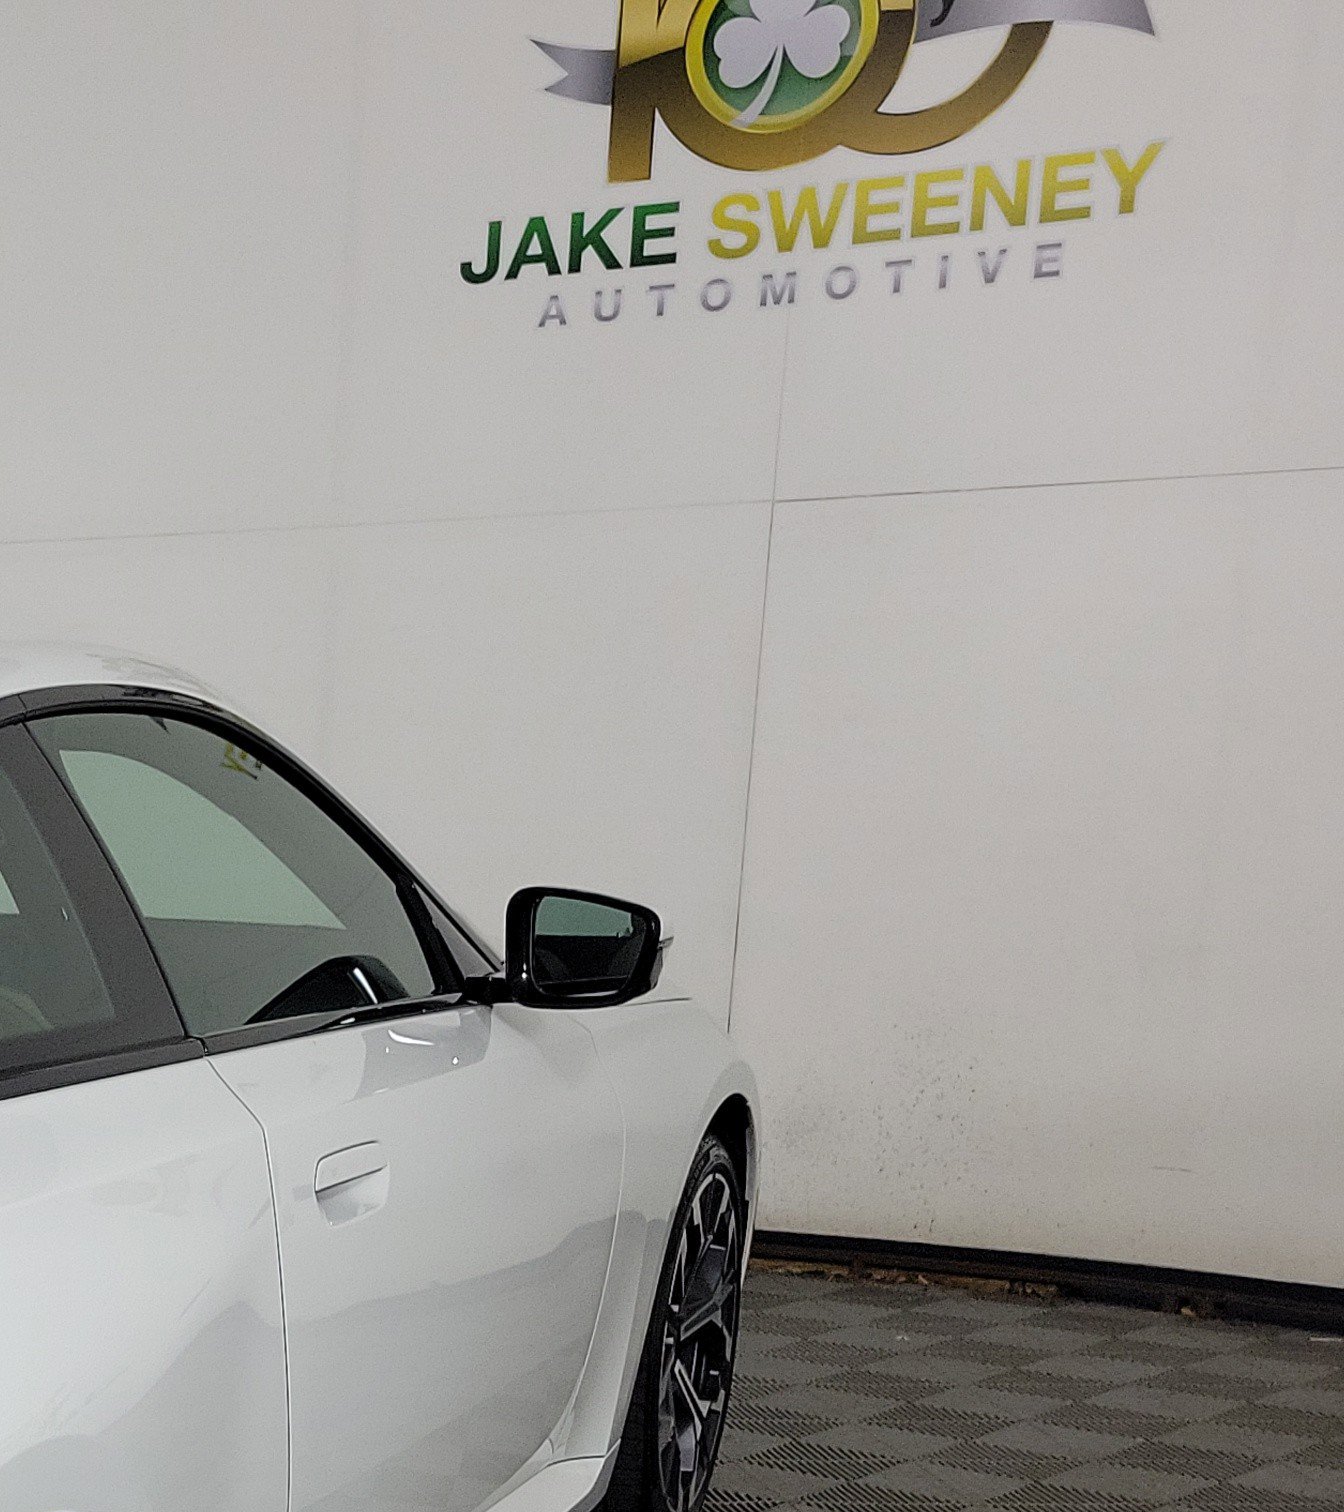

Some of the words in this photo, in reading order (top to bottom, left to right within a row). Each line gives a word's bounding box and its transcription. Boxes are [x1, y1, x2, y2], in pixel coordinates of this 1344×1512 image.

[460, 200, 681, 286] JAKE
[707, 140, 1166, 260] SWEENEY
[537, 242, 1064, 328] AUTOMOTIVE
